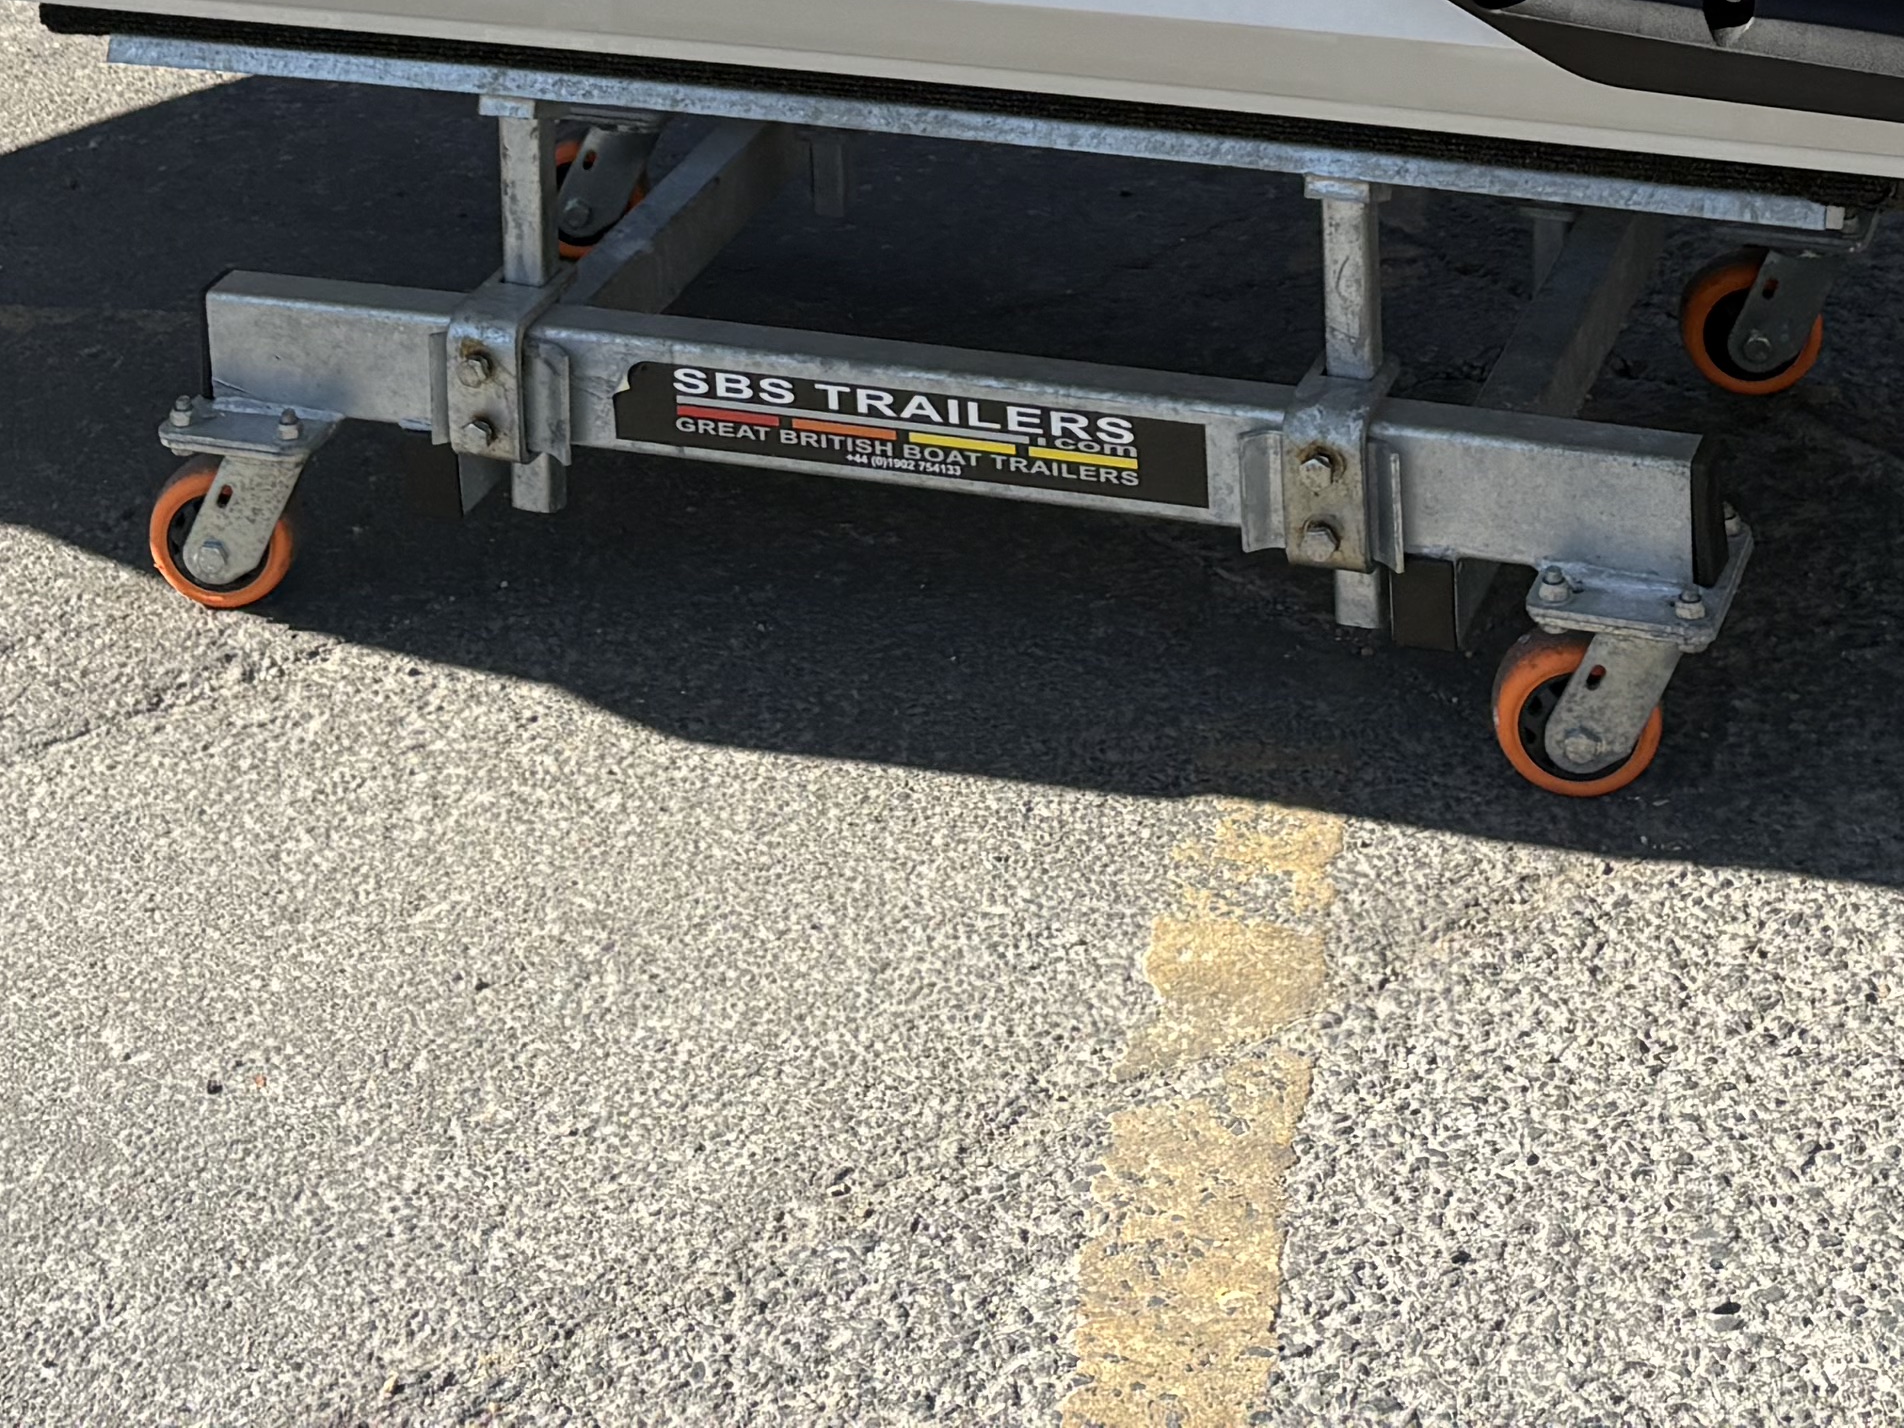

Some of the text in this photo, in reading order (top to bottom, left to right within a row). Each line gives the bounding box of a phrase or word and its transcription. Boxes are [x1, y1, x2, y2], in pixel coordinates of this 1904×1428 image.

[673, 366, 1136, 444] SBS TRAILERS
[675, 417, 1140, 487] GREAT BRITISH BOAT TRAILERS
[846, 452, 962, 477] +44 (0)1902 754133
